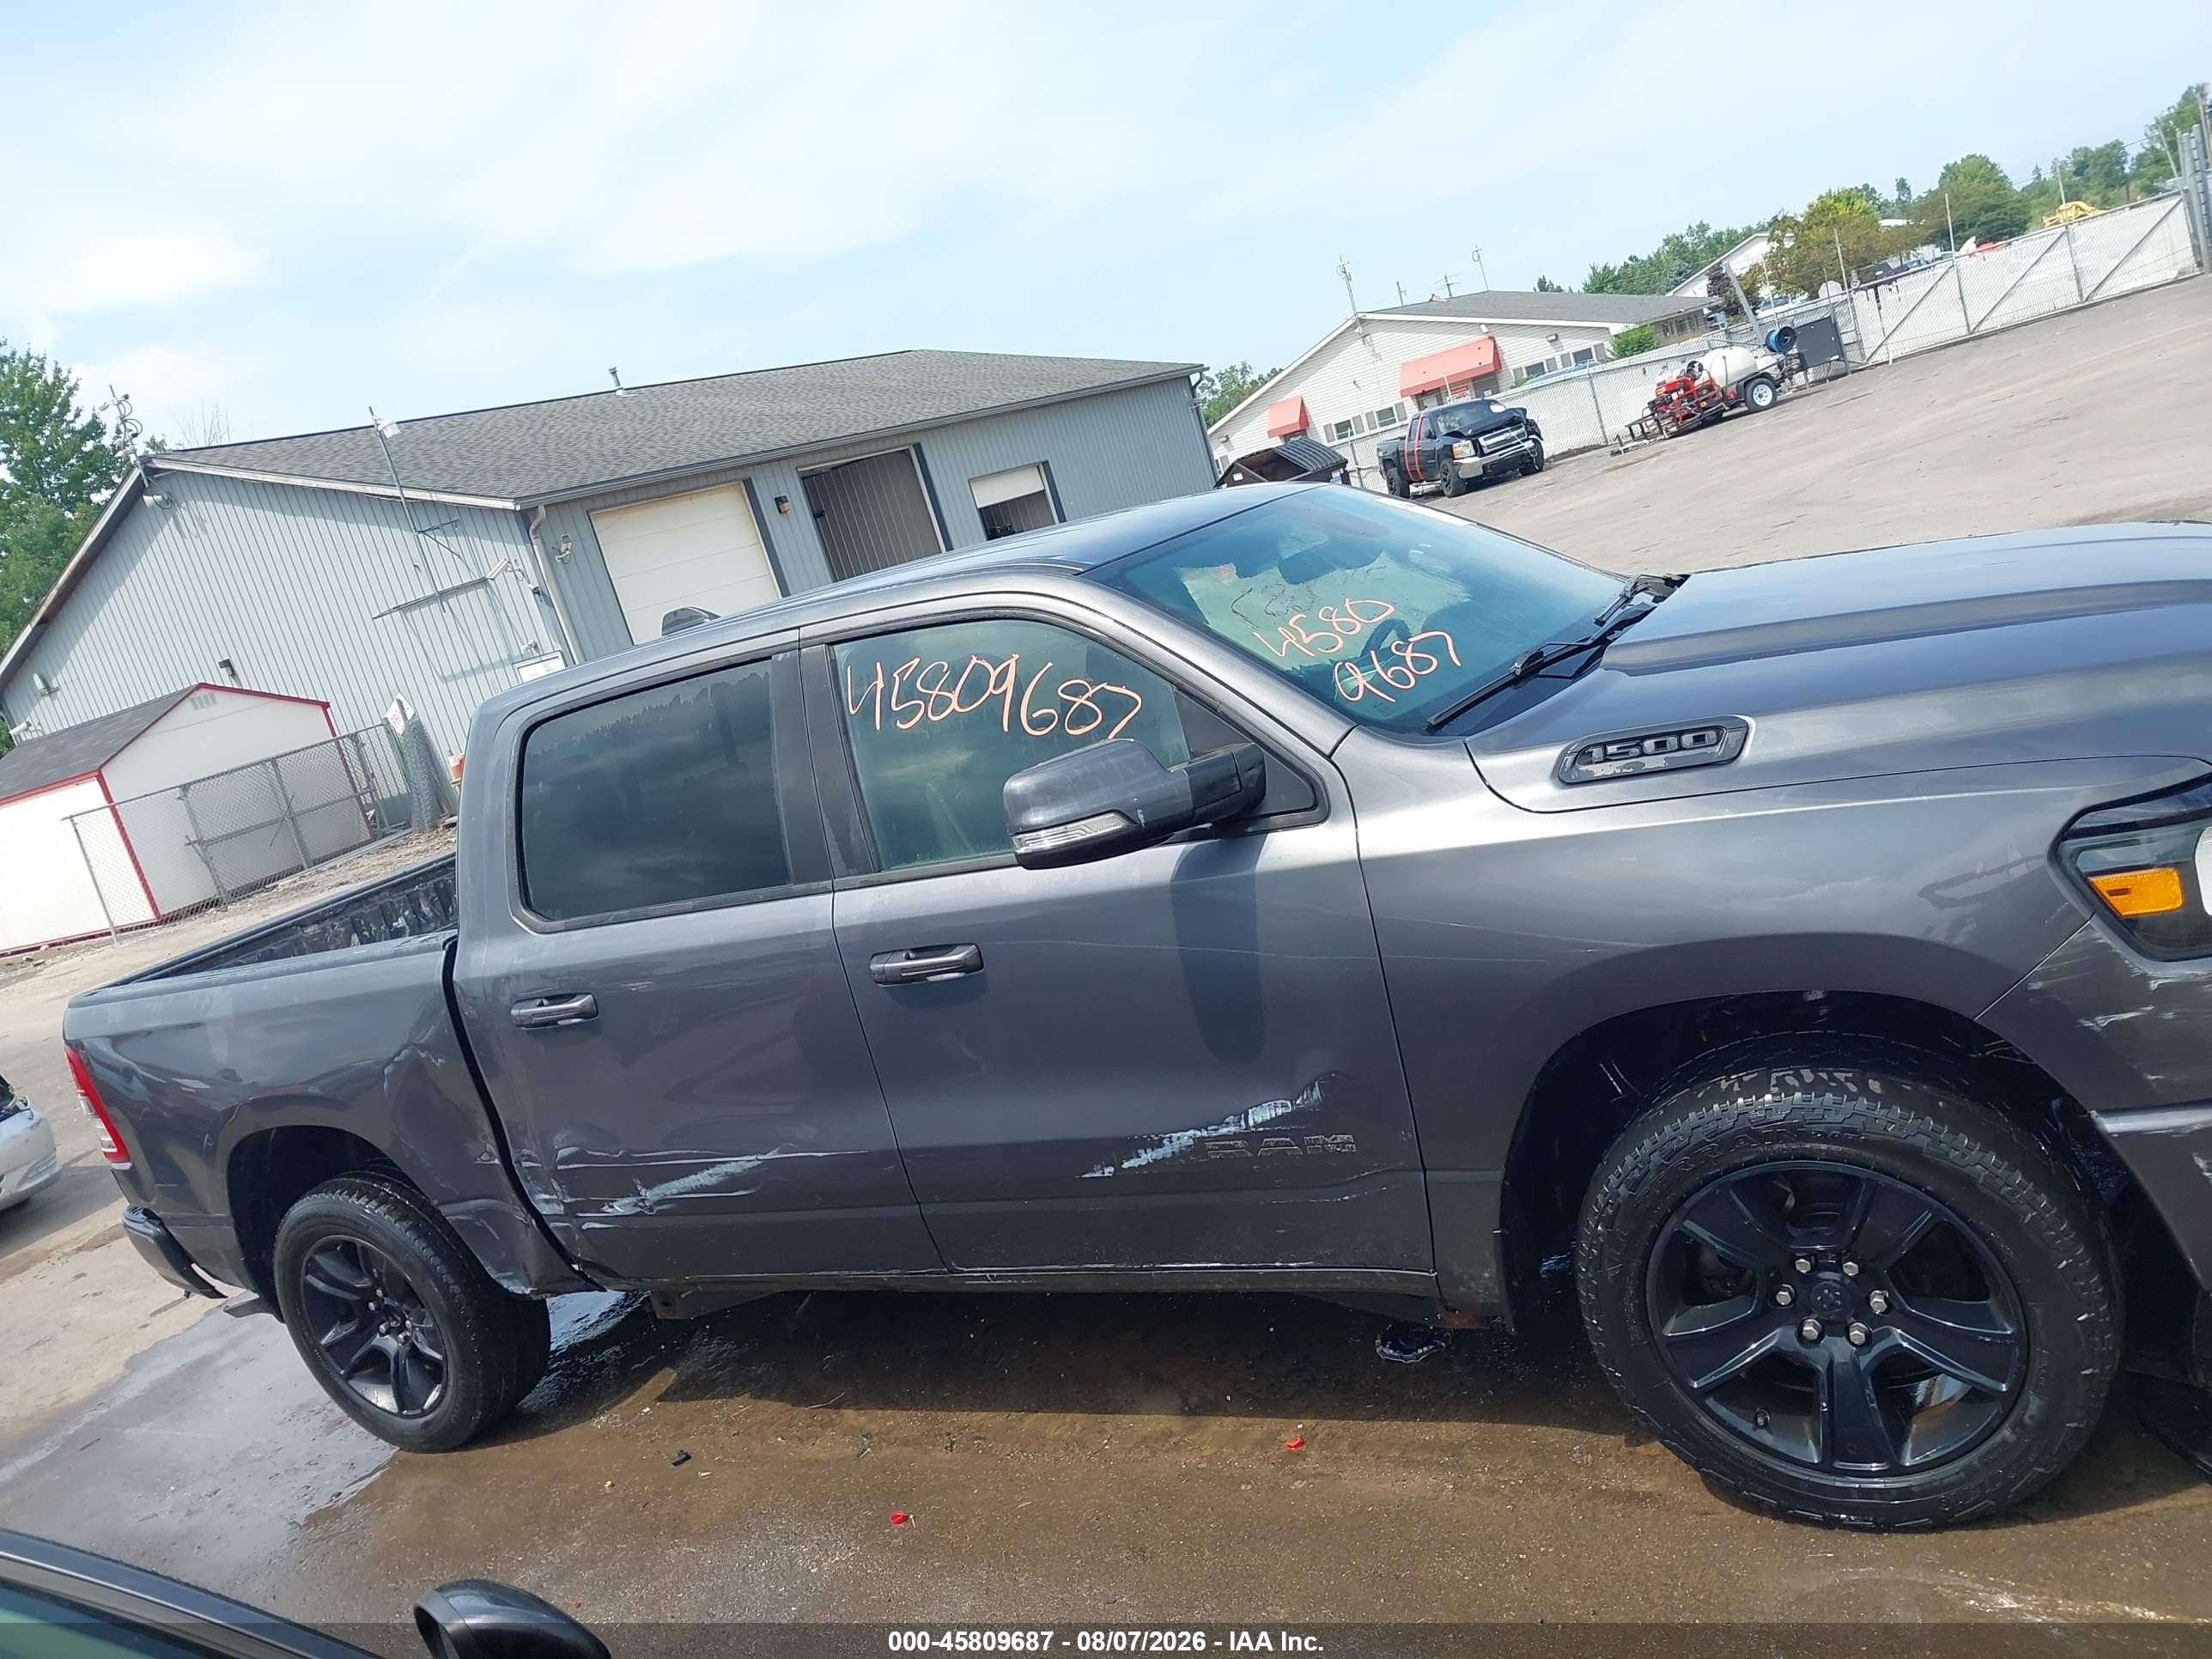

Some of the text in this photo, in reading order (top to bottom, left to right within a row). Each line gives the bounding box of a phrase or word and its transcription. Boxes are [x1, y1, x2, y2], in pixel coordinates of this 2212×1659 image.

[1254, 595, 1395, 657] 4580
[846, 653, 1143, 738] 45809687
[1333, 630, 1462, 702] 9687
[1585, 729, 1720, 763] 1500
[1204, 1134, 1358, 1158] RAM
